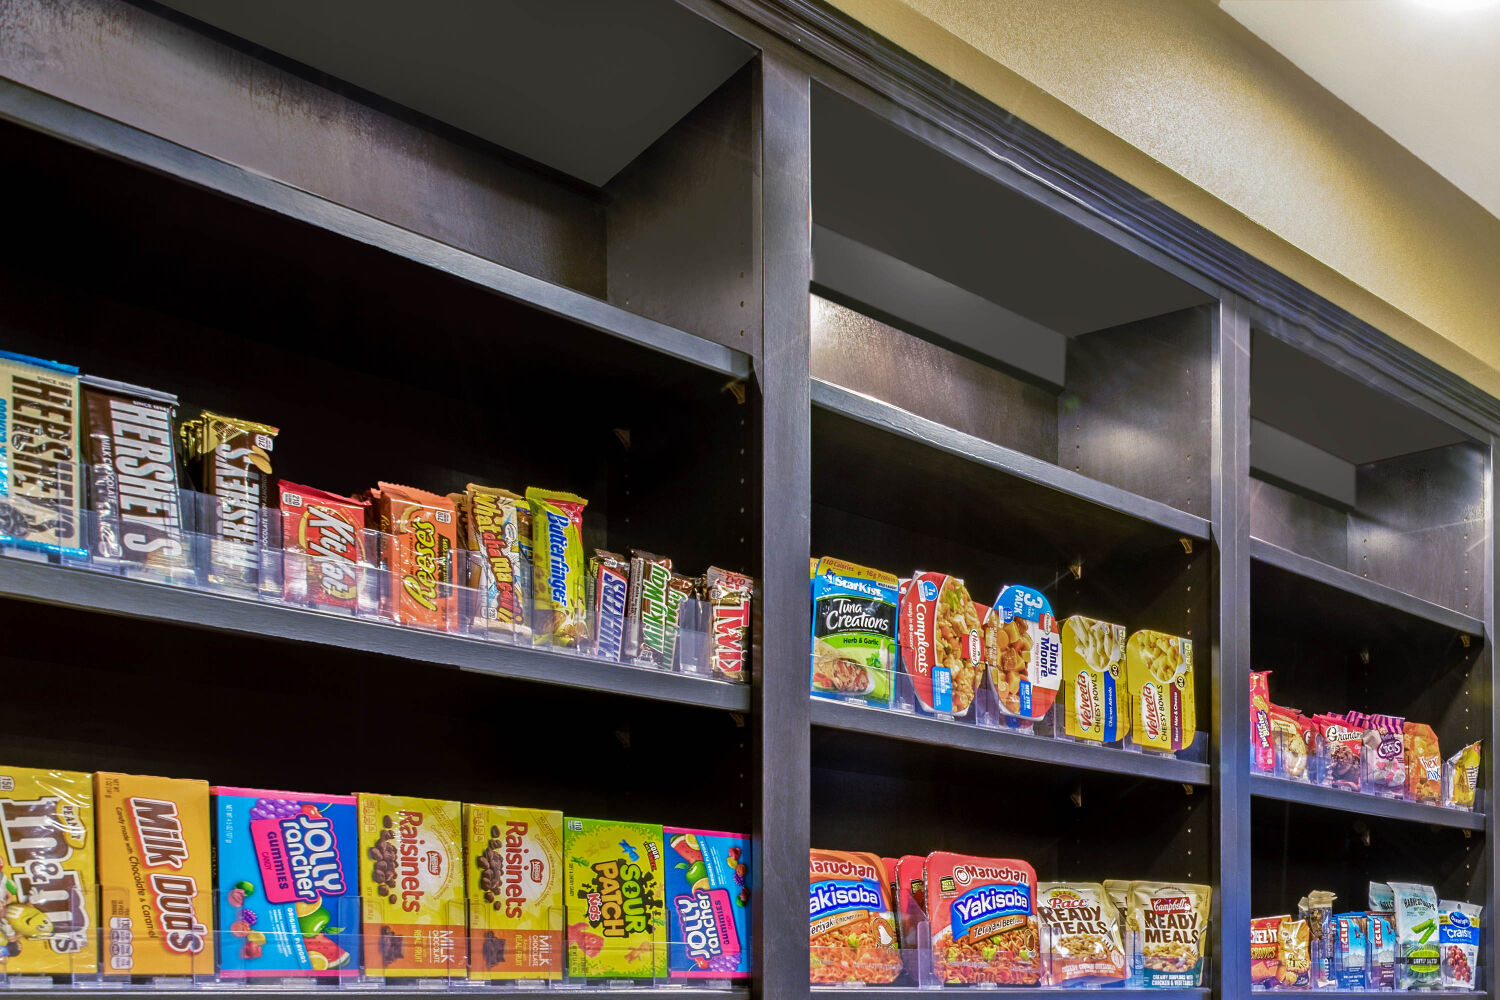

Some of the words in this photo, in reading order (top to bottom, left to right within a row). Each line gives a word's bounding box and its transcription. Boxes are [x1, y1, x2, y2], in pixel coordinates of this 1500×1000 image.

[110, 399, 182, 557] HERSHEY'S
[402, 521, 439, 612] Reese's
[547, 511, 570, 607] Butterfinger
[826, 609, 889, 631] Creations
[833, 599, 863, 614] Tuna
[1013, 588, 1025, 615] PACK
[1023, 592, 1044, 610] 3
[913, 602, 931, 675] Compleats
[1039, 636, 1050, 678] Moore
[1048, 642, 1059, 677] Dinty
[1076, 673, 1093, 728] Velveeta
[1093, 702, 1101, 733] CHEESY
[1142, 685, 1159, 737] Velveeta
[1156, 685, 1164, 712] BOWLS
[1160, 713, 1168, 741] CHEESY
[283, 822, 315, 898] rancher
[299, 816, 342, 890] JOLLY
[399, 810, 425, 913] Raisinets
[505, 820, 529, 919] Raisinets
[967, 864, 1028, 884] Maruchan
[595, 861, 625, 938] PATCH
[620, 864, 647, 933] SOUR
[956, 889, 1028, 922] Yakisoba
[1144, 909, 1199, 930] READY
[678, 898, 710, 959] JOLLY
[696, 893, 721, 955] rancher
[1144, 929, 1199, 944] MEALS
[440, 930, 456, 964] MILK
[538, 935, 552, 967] MILK
